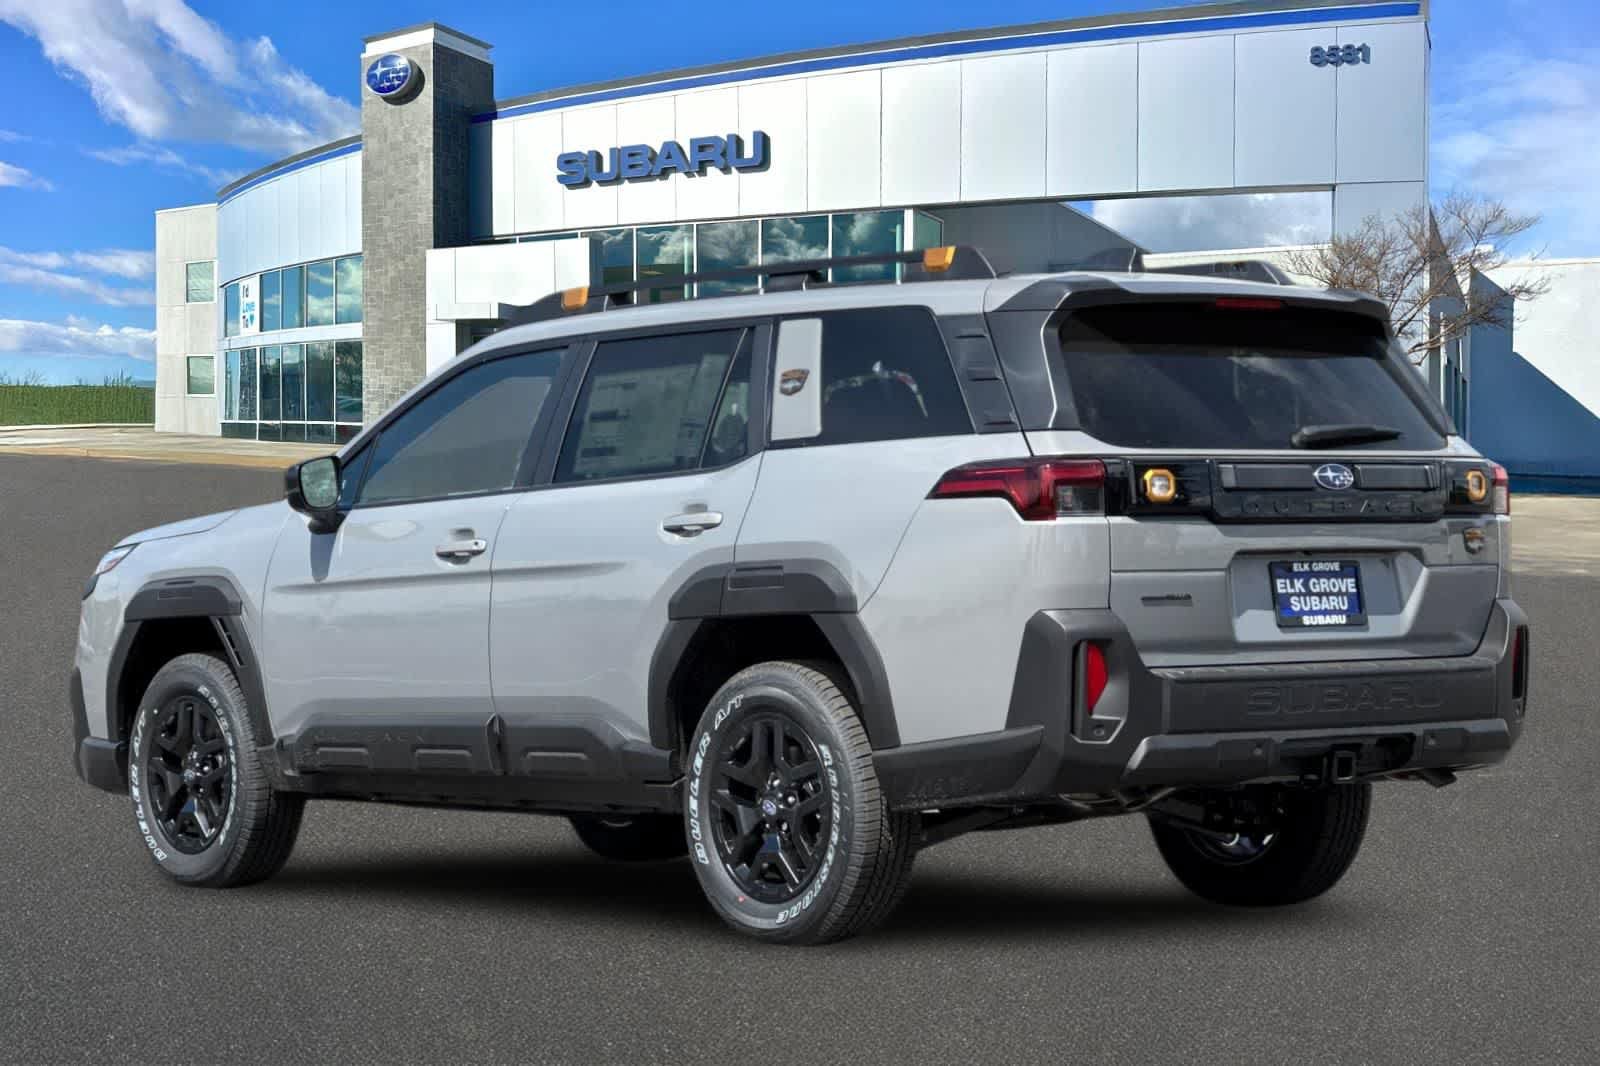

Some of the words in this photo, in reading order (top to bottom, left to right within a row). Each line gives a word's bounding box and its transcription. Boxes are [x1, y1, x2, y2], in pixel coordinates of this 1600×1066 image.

[557, 130, 769, 189] SUBARU
[1241, 499, 1424, 514] OUTBACK
[1293, 563, 1310, 572] ELK
[1312, 562, 1341, 572] GROVE
[1276, 578, 1306, 593] ELK
[1309, 578, 1357, 593] GROVE
[1289, 595, 1349, 612] SUBARU
[1302, 614, 1347, 626] SUBARU
[1248, 681, 1443, 716] SUBARU
[714, 693, 745, 731] A/T
